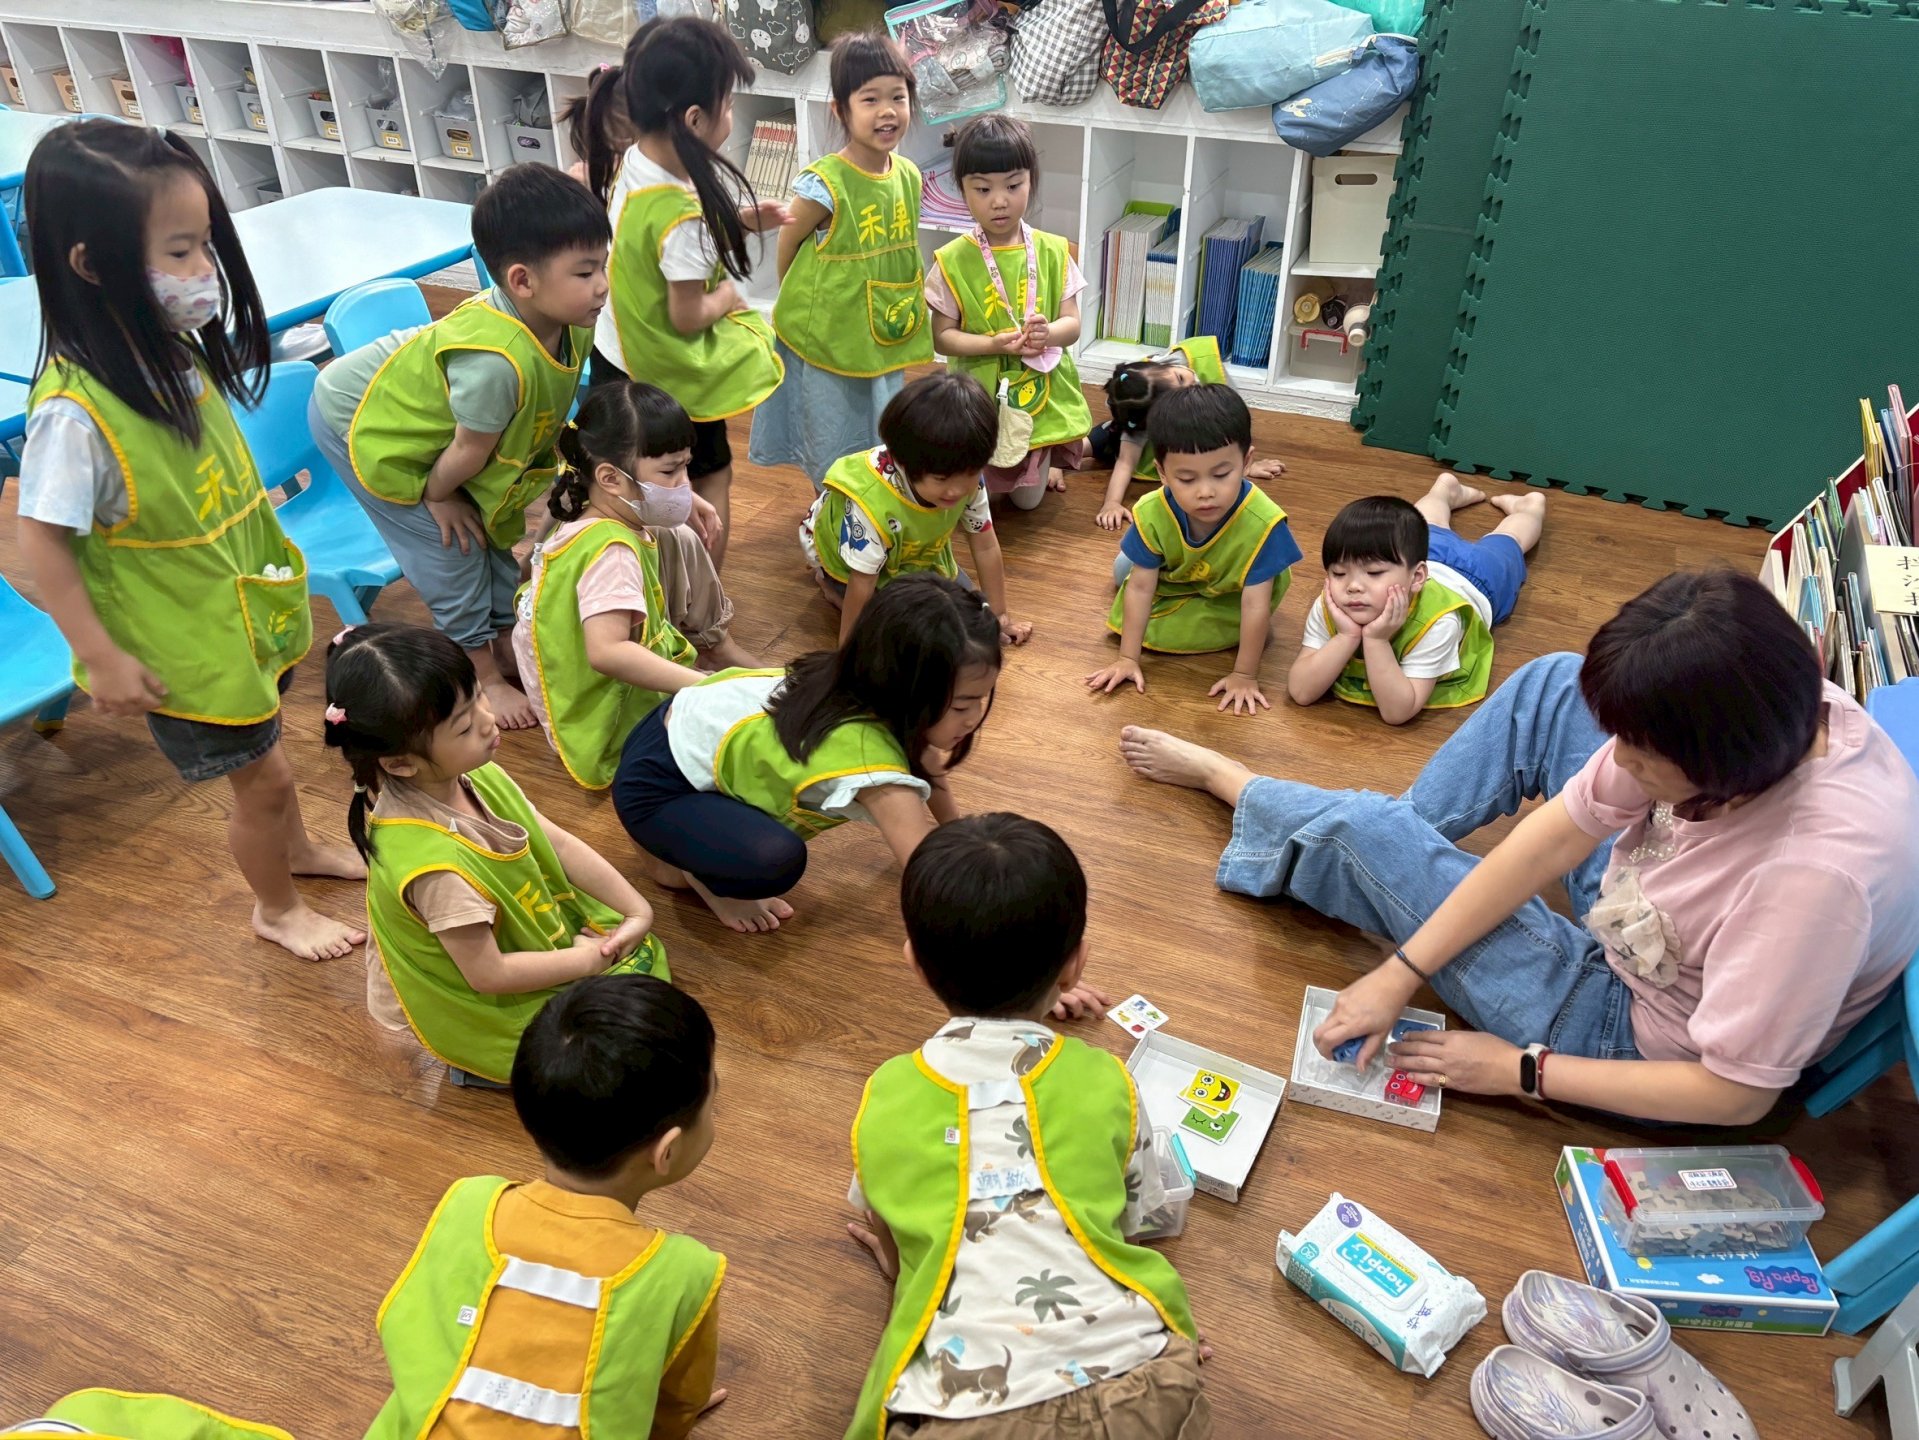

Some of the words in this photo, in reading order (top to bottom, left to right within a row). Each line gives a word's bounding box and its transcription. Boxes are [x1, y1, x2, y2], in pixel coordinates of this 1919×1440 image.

[1299, 1246, 1313, 1260] 80
[1745, 1268, 1775, 1290] Pig
[1771, 1270, 1819, 1294] Peppa
